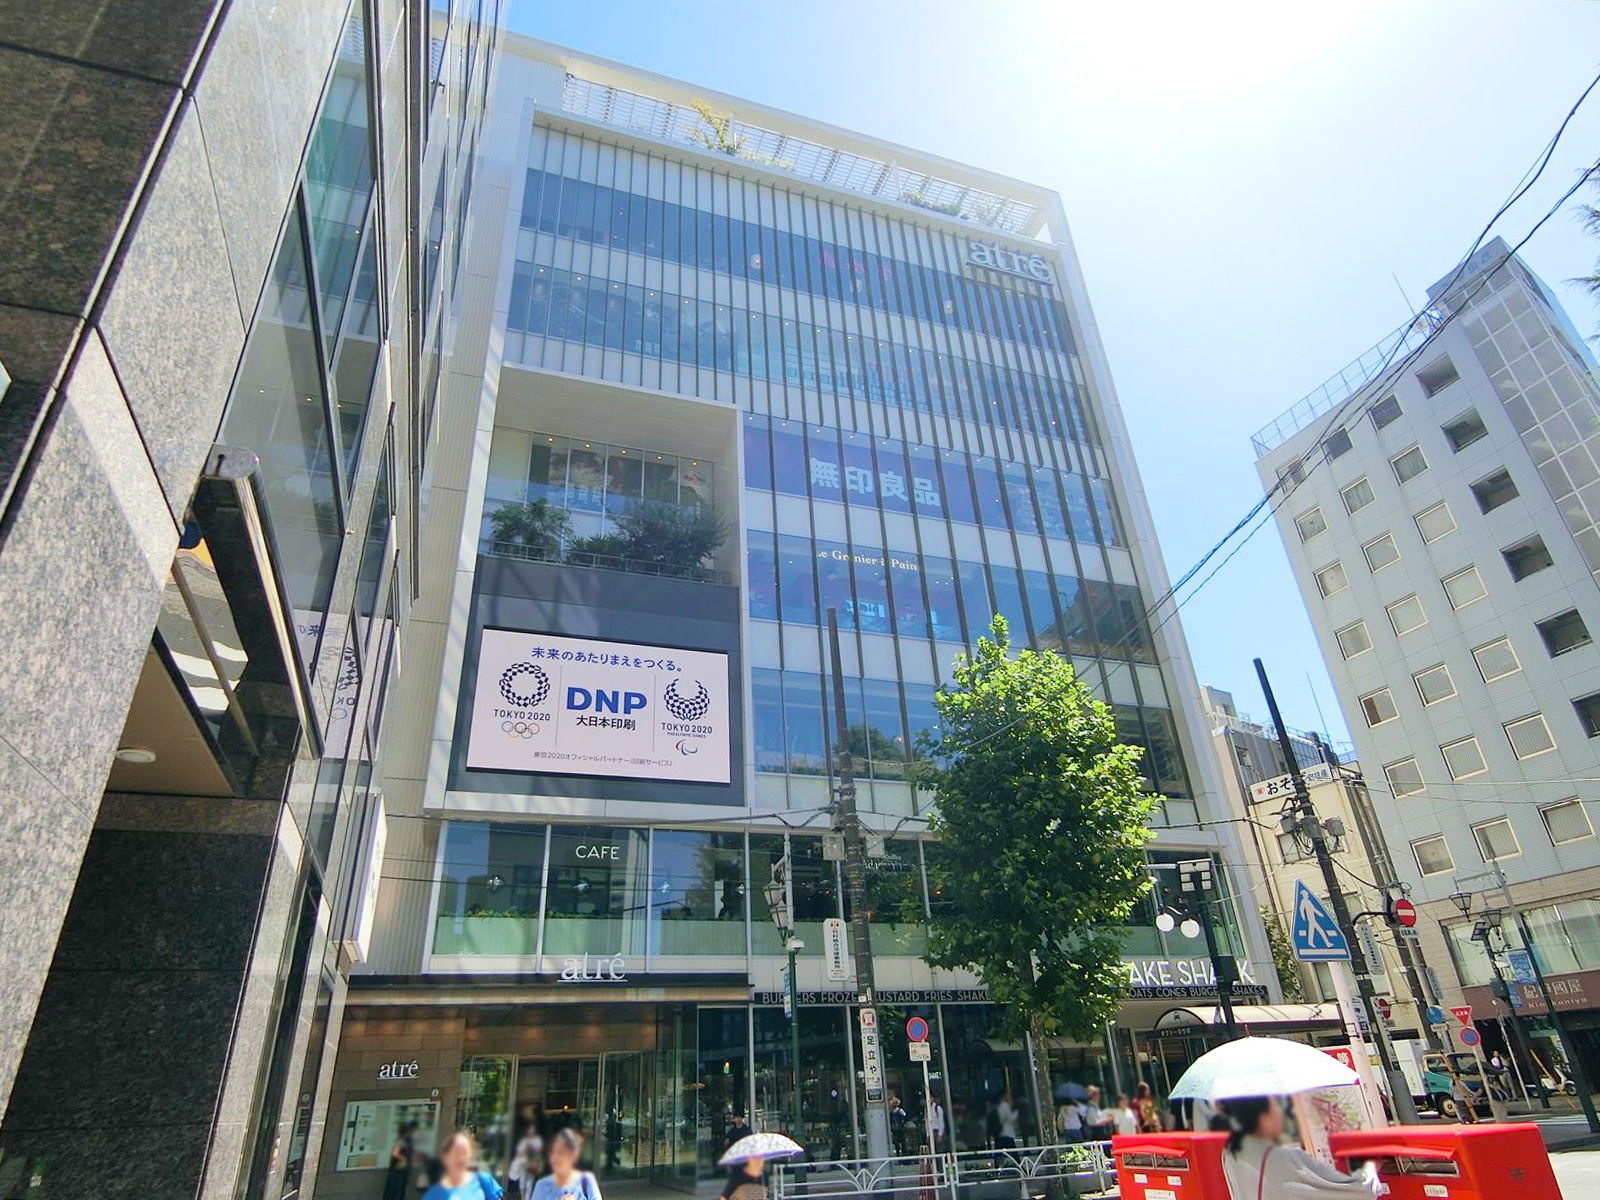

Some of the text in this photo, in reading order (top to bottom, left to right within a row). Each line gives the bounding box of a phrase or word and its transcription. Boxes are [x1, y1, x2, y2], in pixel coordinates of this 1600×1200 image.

[810, 457, 941, 506] 無印良品
[832, 550, 876, 565] Grnier
[891, 558, 918, 571] Pain
[531, 647, 682, 672] 未来のあたりまえをつくる。
[566, 686, 648, 715] DNP
[494, 708, 551, 722] TOKYO 2020
[576, 715, 636, 731] 大日本印刷
[661, 722, 713, 735] TOKYO 2020
[575, 845, 620, 860] CAFE
[561, 951, 626, 980] atré
[1129, 960, 1175, 986] AKE
[762, 992, 817, 1004] BURERS
[821, 991, 858, 1003] FROZE
[924, 990, 953, 1002] FRIES
[1130, 985, 1265, 998] OATS CONES BURGE SHAKES
[1528, 997, 1588, 1010] Kinkuniya
[866, 1035, 877, 1074] 足立や
[379, 1059, 419, 1078] atré
